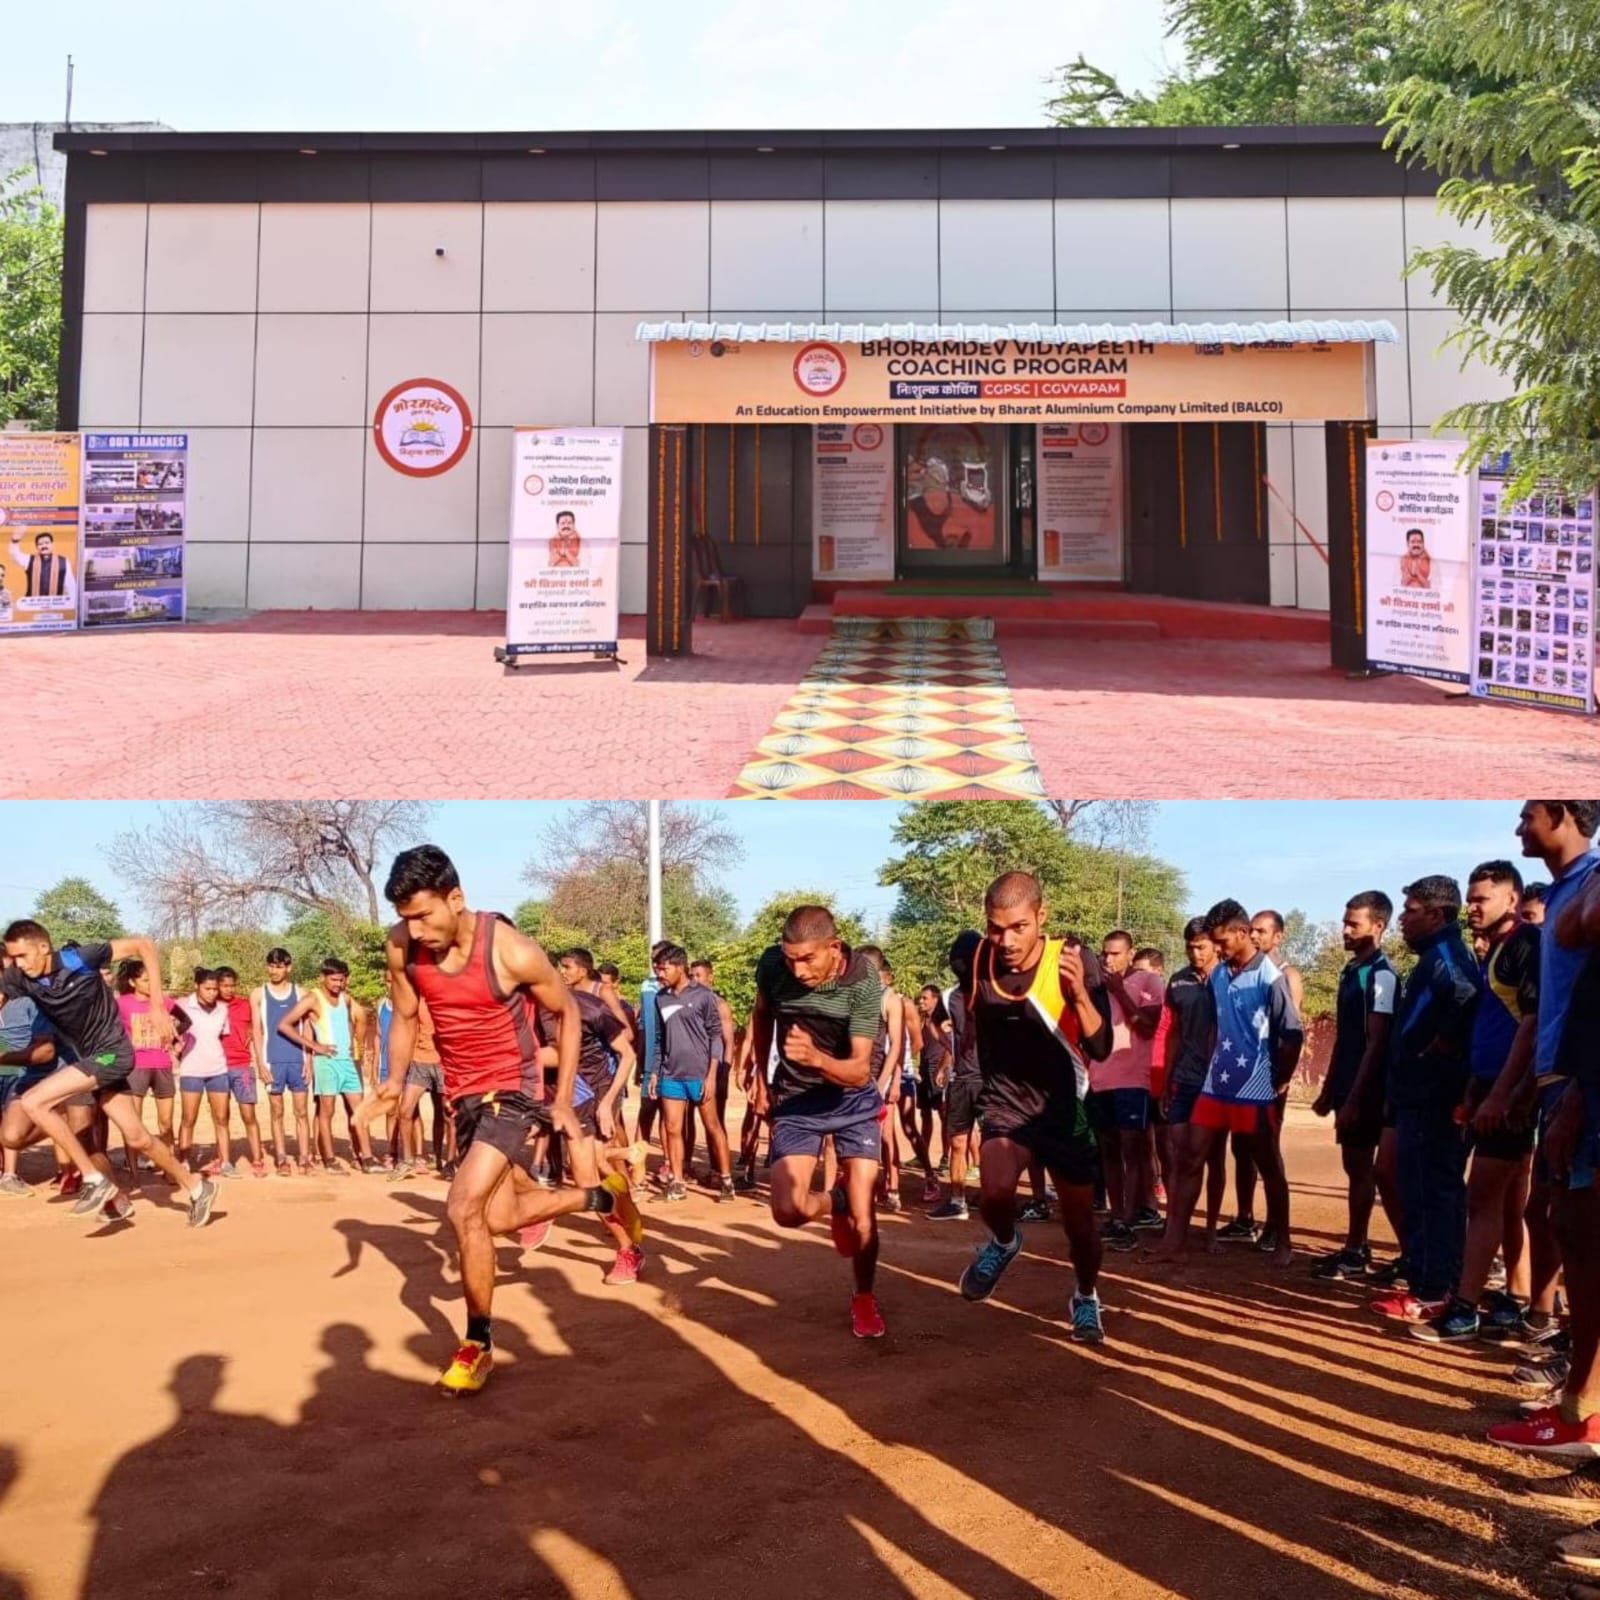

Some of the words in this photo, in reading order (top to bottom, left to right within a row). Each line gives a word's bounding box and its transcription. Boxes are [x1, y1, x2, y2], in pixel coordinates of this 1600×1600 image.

[861, 339, 1008, 356] BHORAMDEV
[1013, 340, 1154, 355] VIDYAPEETH
[887, 359, 1006, 375] COACHING
[1013, 358, 1127, 374] PROGRAM
[942, 381, 977, 396] कोचिंग
[984, 383, 1030, 395] CGPSC
[1041, 383, 1119, 395] CGVYAPAM
[736, 404, 753, 416] An
[756, 404, 820, 416] Education
[822, 404, 916, 418] Empowerment
[920, 404, 977, 416] Initiative
[980, 404, 995, 417] by
[999, 404, 1042, 415] Bharat
[1045, 403, 1114, 415] Aluminium
[1117, 403, 1176, 416] Company
[1180, 402, 1229, 414] Limited
[1232, 401, 1283, 414] (BALCO)
[108, 436, 130, 448] OUR
[132, 436, 185, 448] BRANCHES
